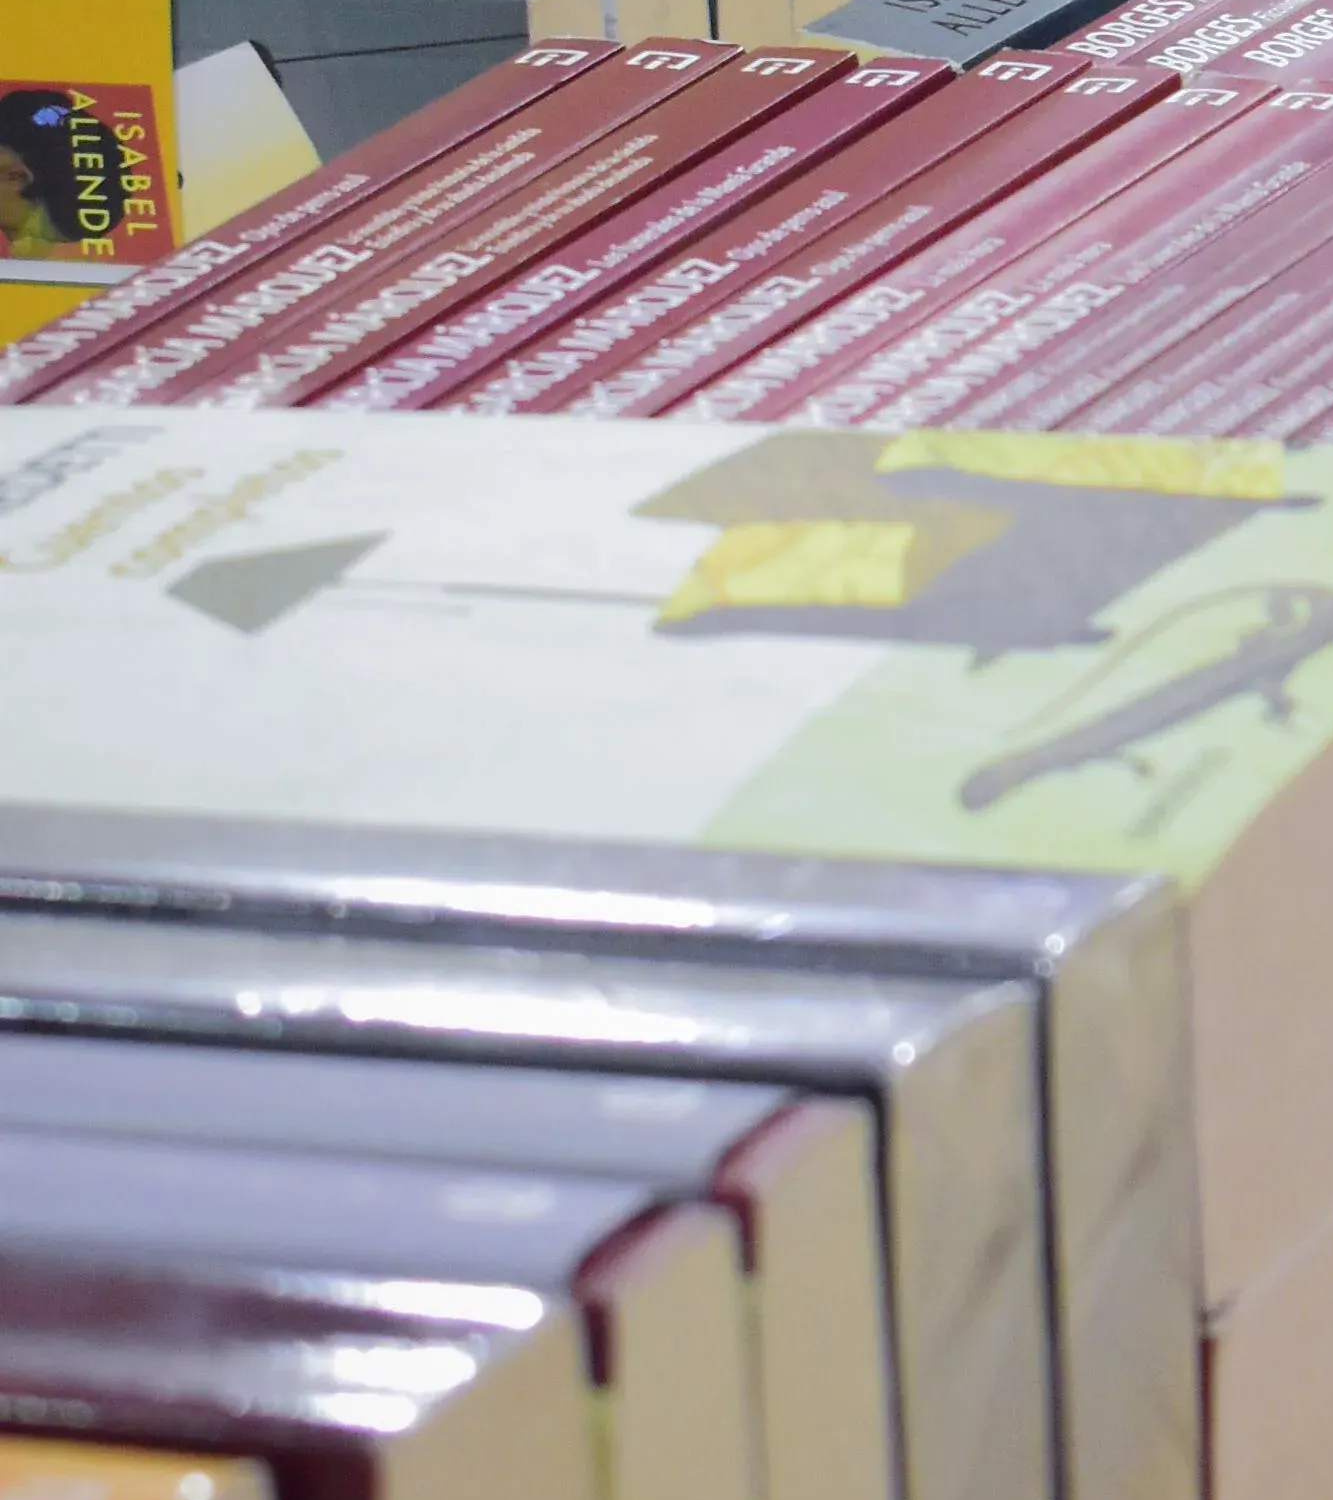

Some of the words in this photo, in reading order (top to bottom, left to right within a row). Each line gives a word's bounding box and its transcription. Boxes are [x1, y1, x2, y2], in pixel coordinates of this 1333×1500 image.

[1147, 13, 1264, 72] BORGES
[67, 88, 116, 258] ALLENDE
[113, 110, 159, 237] ISABEL
